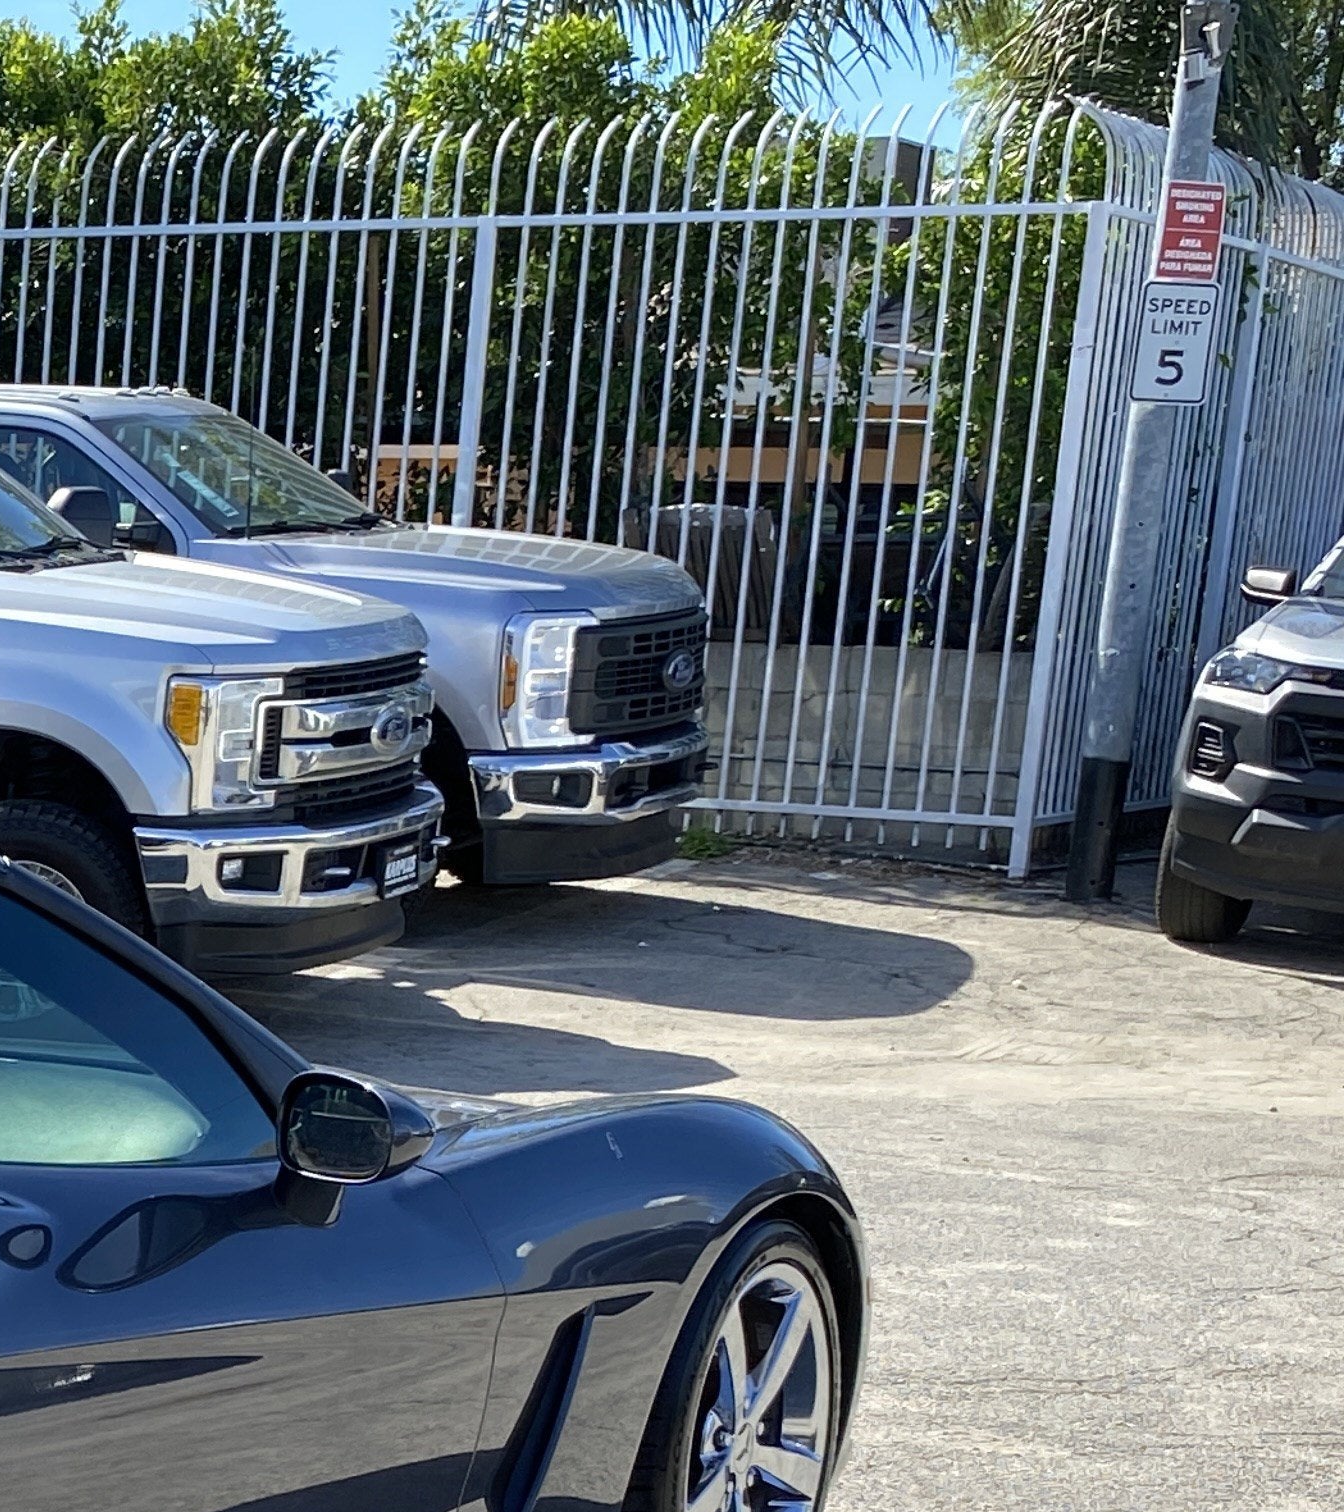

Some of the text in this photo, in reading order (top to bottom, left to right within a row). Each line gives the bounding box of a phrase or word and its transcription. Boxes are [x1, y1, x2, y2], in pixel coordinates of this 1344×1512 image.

[1182, 213, 1206, 224] AREA
[1147, 297, 1211, 316] SPEED
[1151, 319, 1203, 337] LIMIT
[1154, 350, 1184, 386] 5
